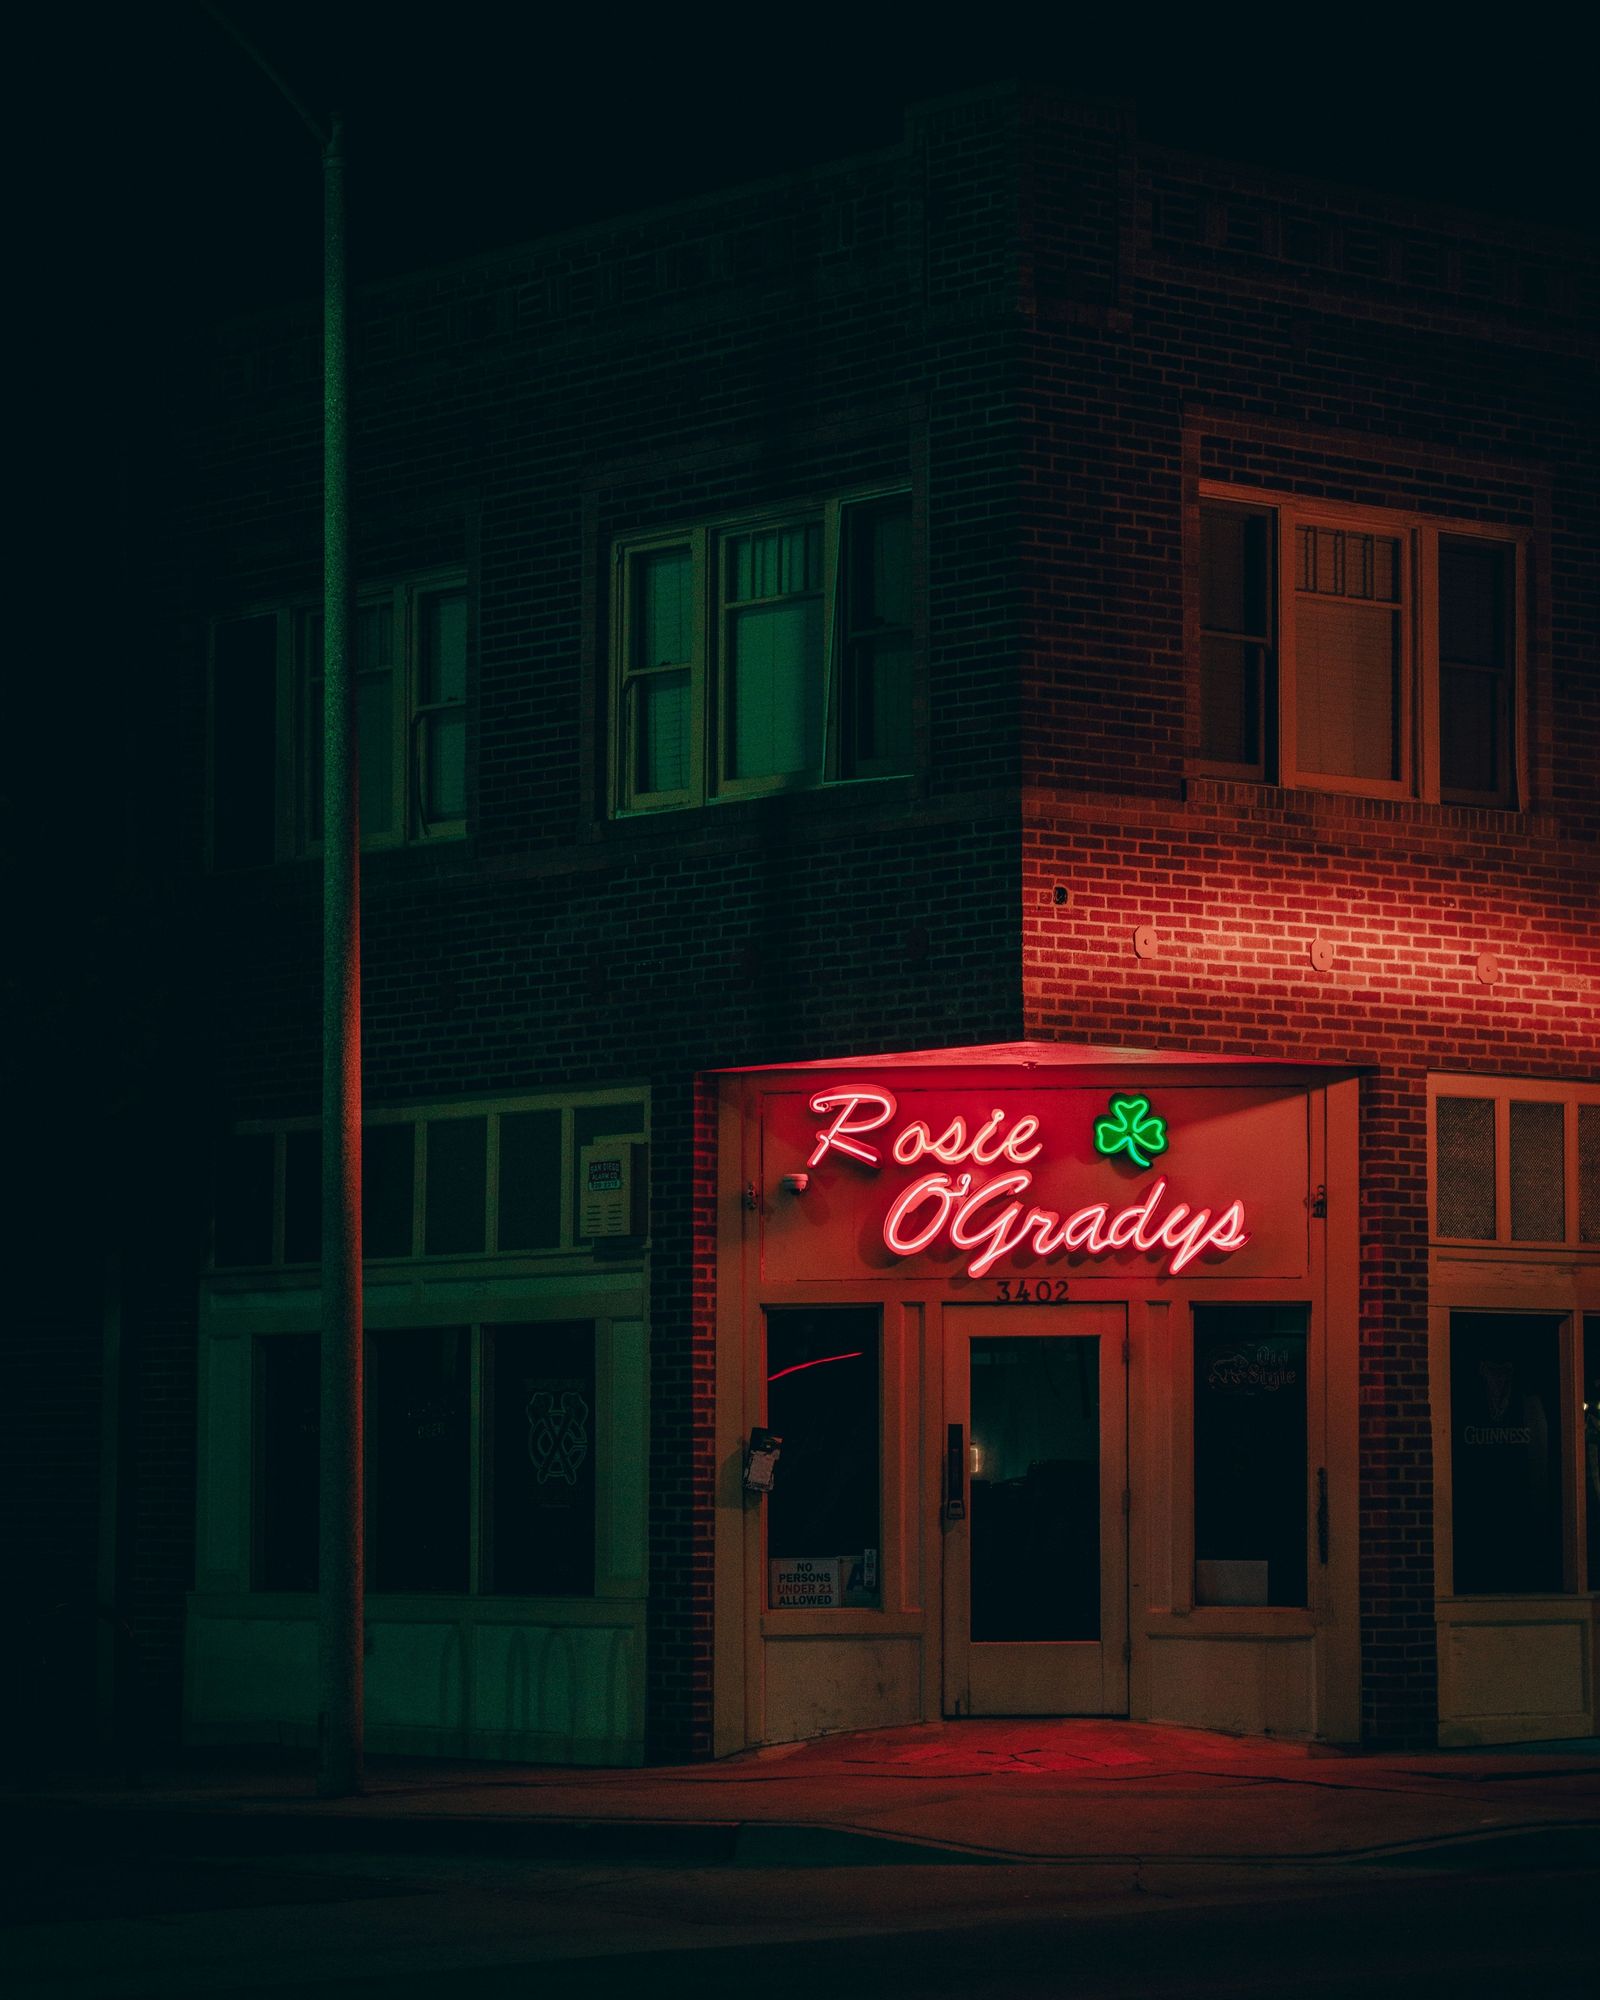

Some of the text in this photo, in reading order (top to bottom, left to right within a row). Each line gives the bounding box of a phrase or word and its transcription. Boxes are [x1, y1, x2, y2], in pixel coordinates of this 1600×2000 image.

[807, 1084, 1043, 1166] Rosie
[884, 1170, 1251, 1278] O'Gradys
[997, 1281, 1069, 1301] 3402
[1463, 1425, 1530, 1445] GUINNESS
[796, 1562, 813, 1572] NO
[779, 1573, 831, 1583] PERSONS
[777, 1584, 833, 1595] UNDER 21
[778, 1595, 832, 1606] ALLOWED
